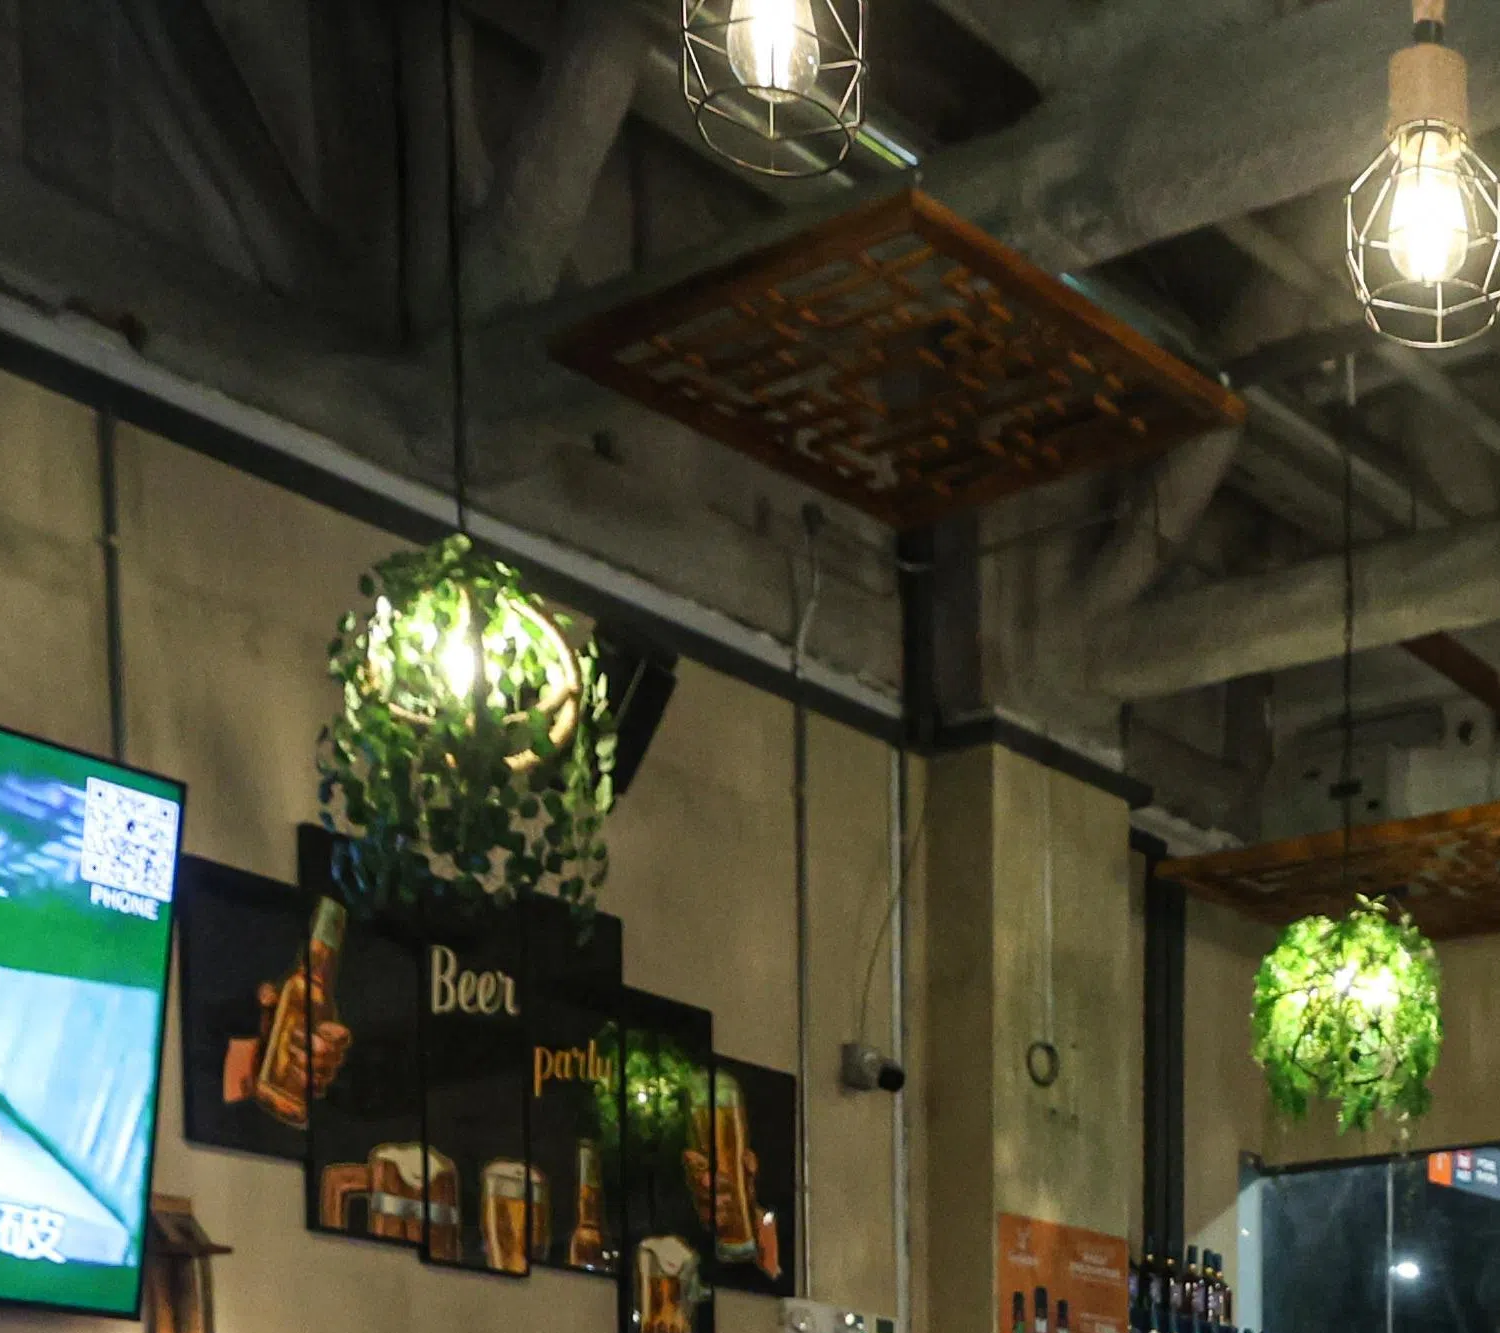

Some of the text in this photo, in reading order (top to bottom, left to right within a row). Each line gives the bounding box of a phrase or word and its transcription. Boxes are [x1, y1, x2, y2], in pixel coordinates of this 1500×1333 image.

[90, 882, 159, 921] PHONE
[430, 944, 520, 1016] Beer
[533, 1039, 613, 1097] party
